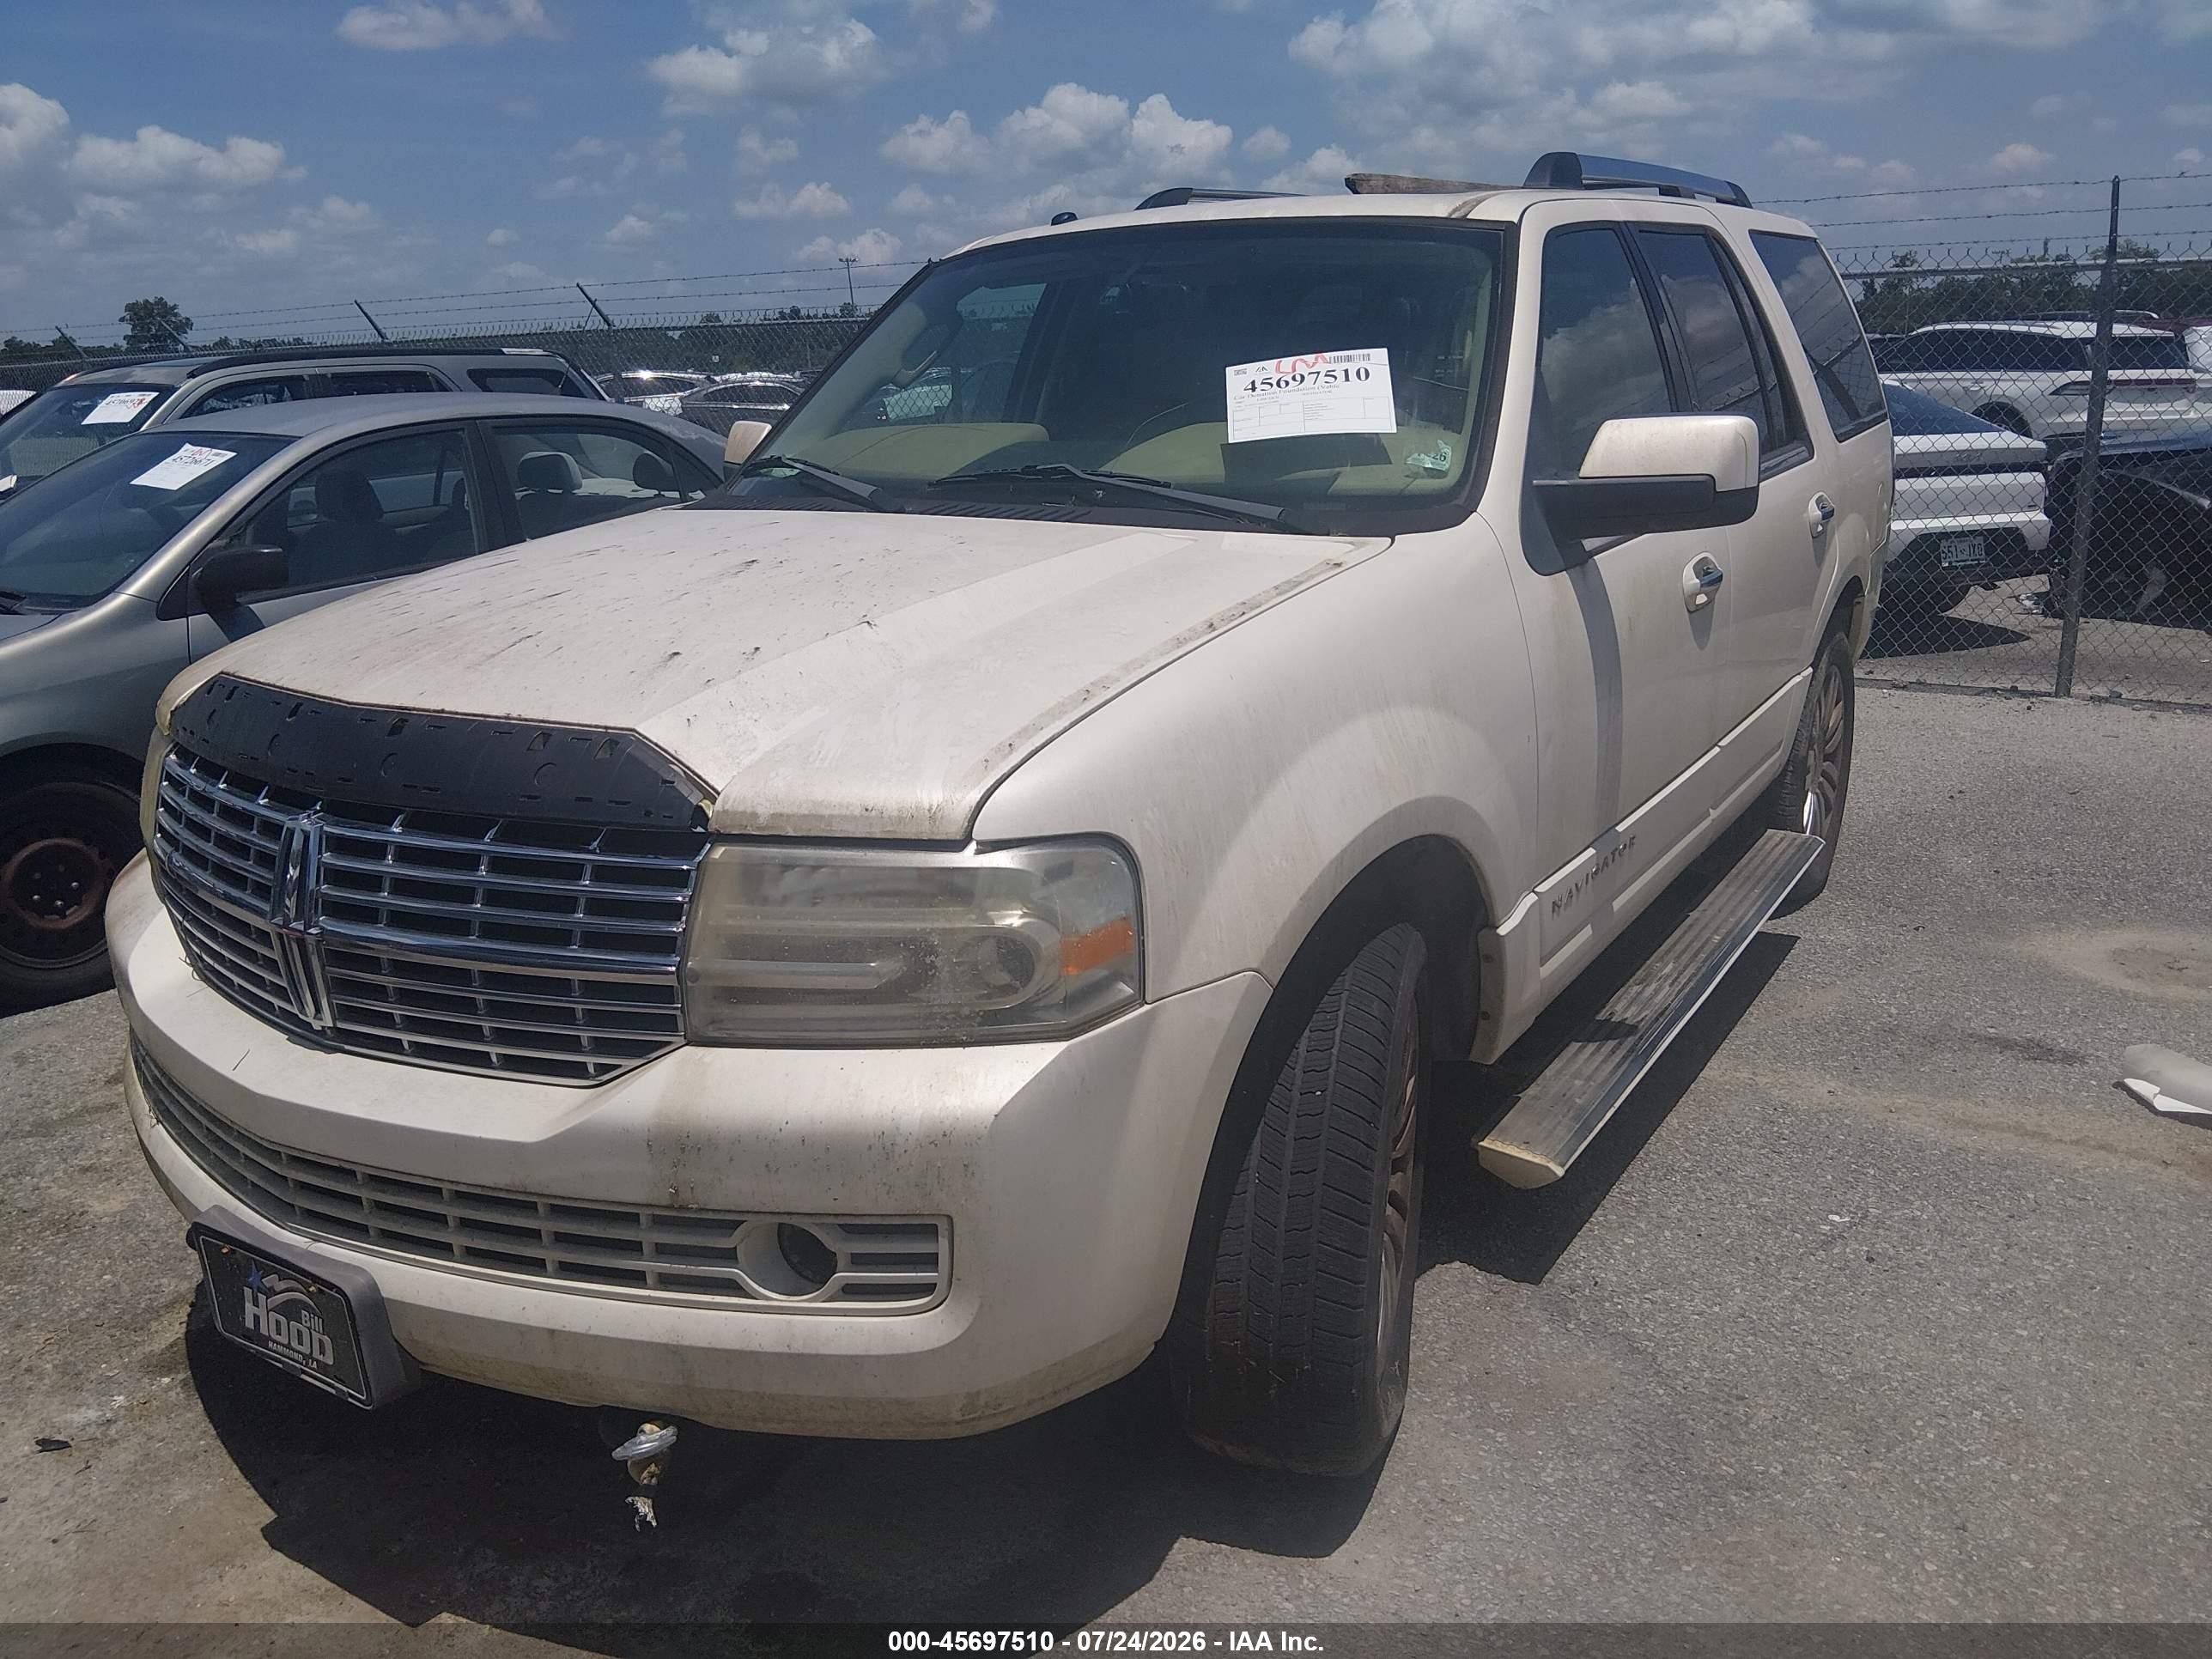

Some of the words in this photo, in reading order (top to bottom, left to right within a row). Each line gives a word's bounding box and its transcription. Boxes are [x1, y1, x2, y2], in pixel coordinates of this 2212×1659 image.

[1243, 366, 1370, 393] 45697510
[301, 1309, 324, 1334] Bill
[308, 1358, 318, 1370] LA
